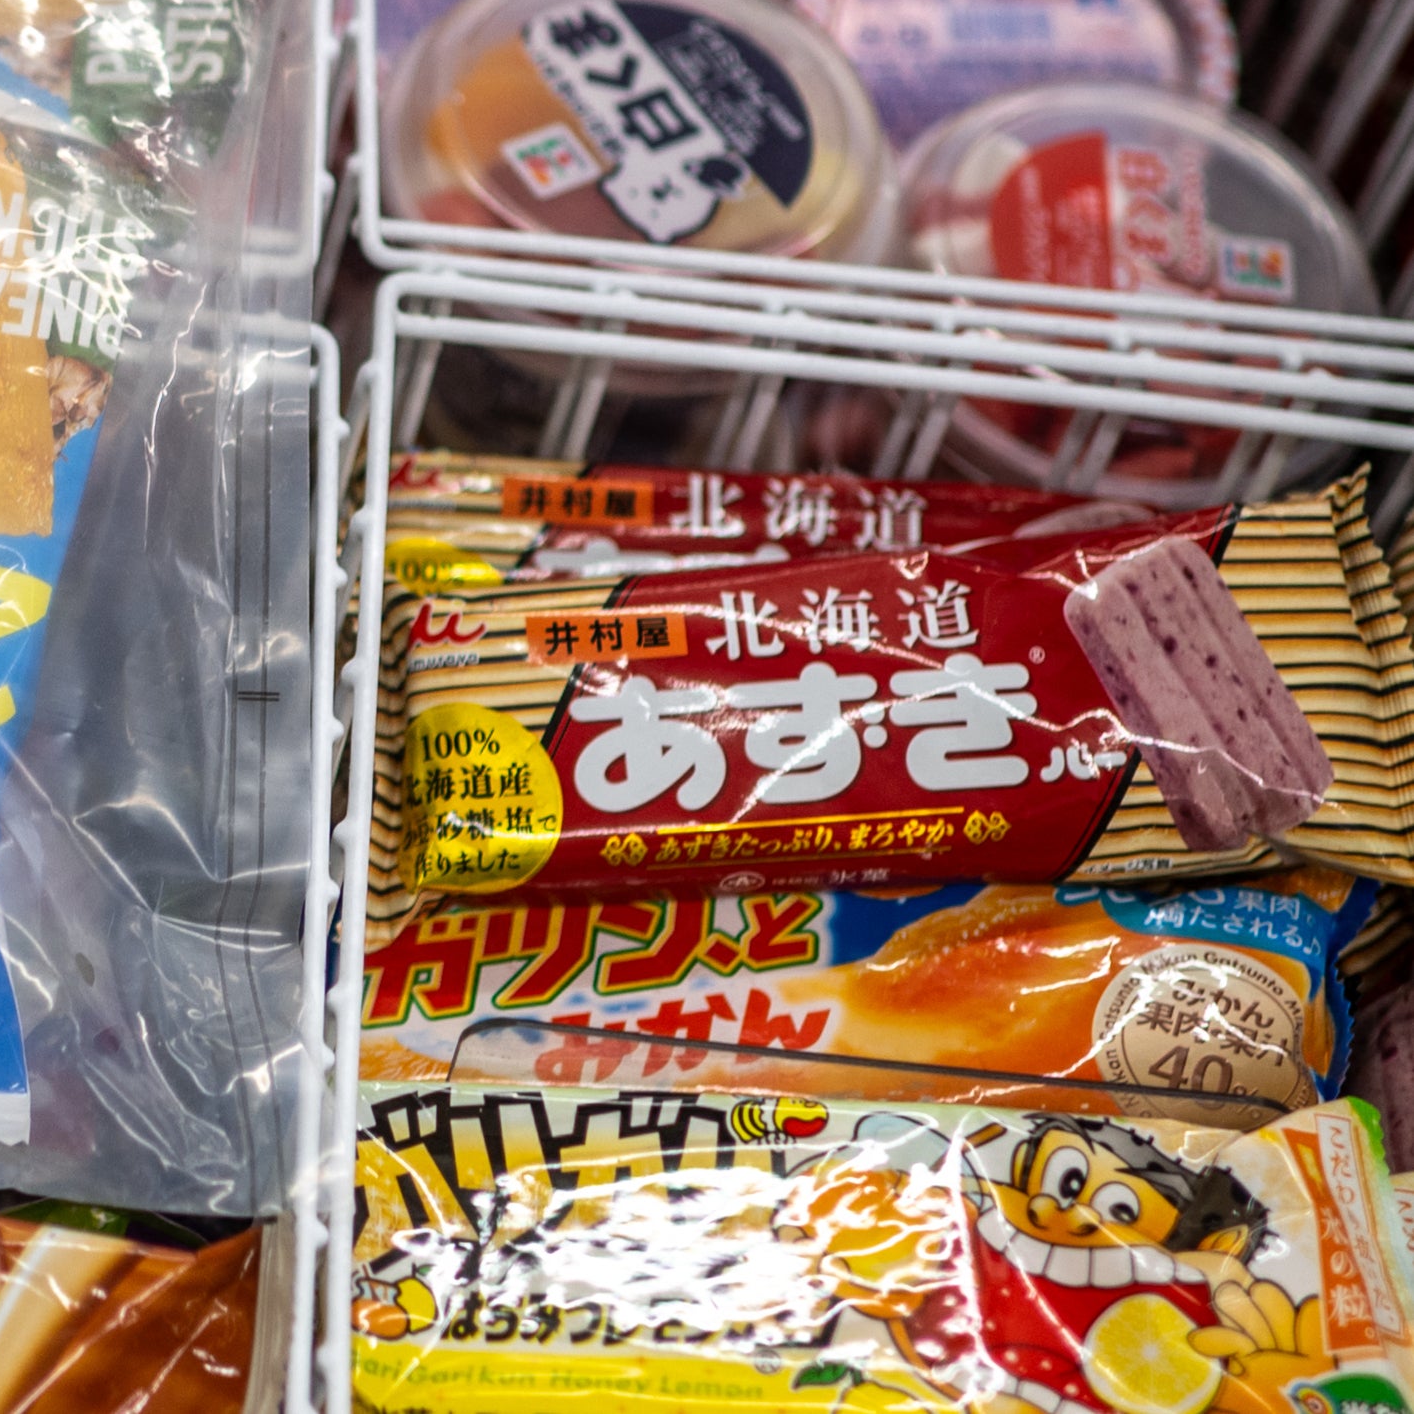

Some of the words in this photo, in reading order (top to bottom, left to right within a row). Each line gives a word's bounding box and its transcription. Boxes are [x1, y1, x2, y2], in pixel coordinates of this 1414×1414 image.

[518, 486, 638, 518] 井村屋
[669, 472, 929, 549] 北海道
[544, 614, 672, 657] 井村屋
[704, 581, 980, 663] 北海道
[421, 728, 501, 762] 100%
[534, 985, 833, 1084] みかん
[1170, 976, 1275, 1031] みかん
